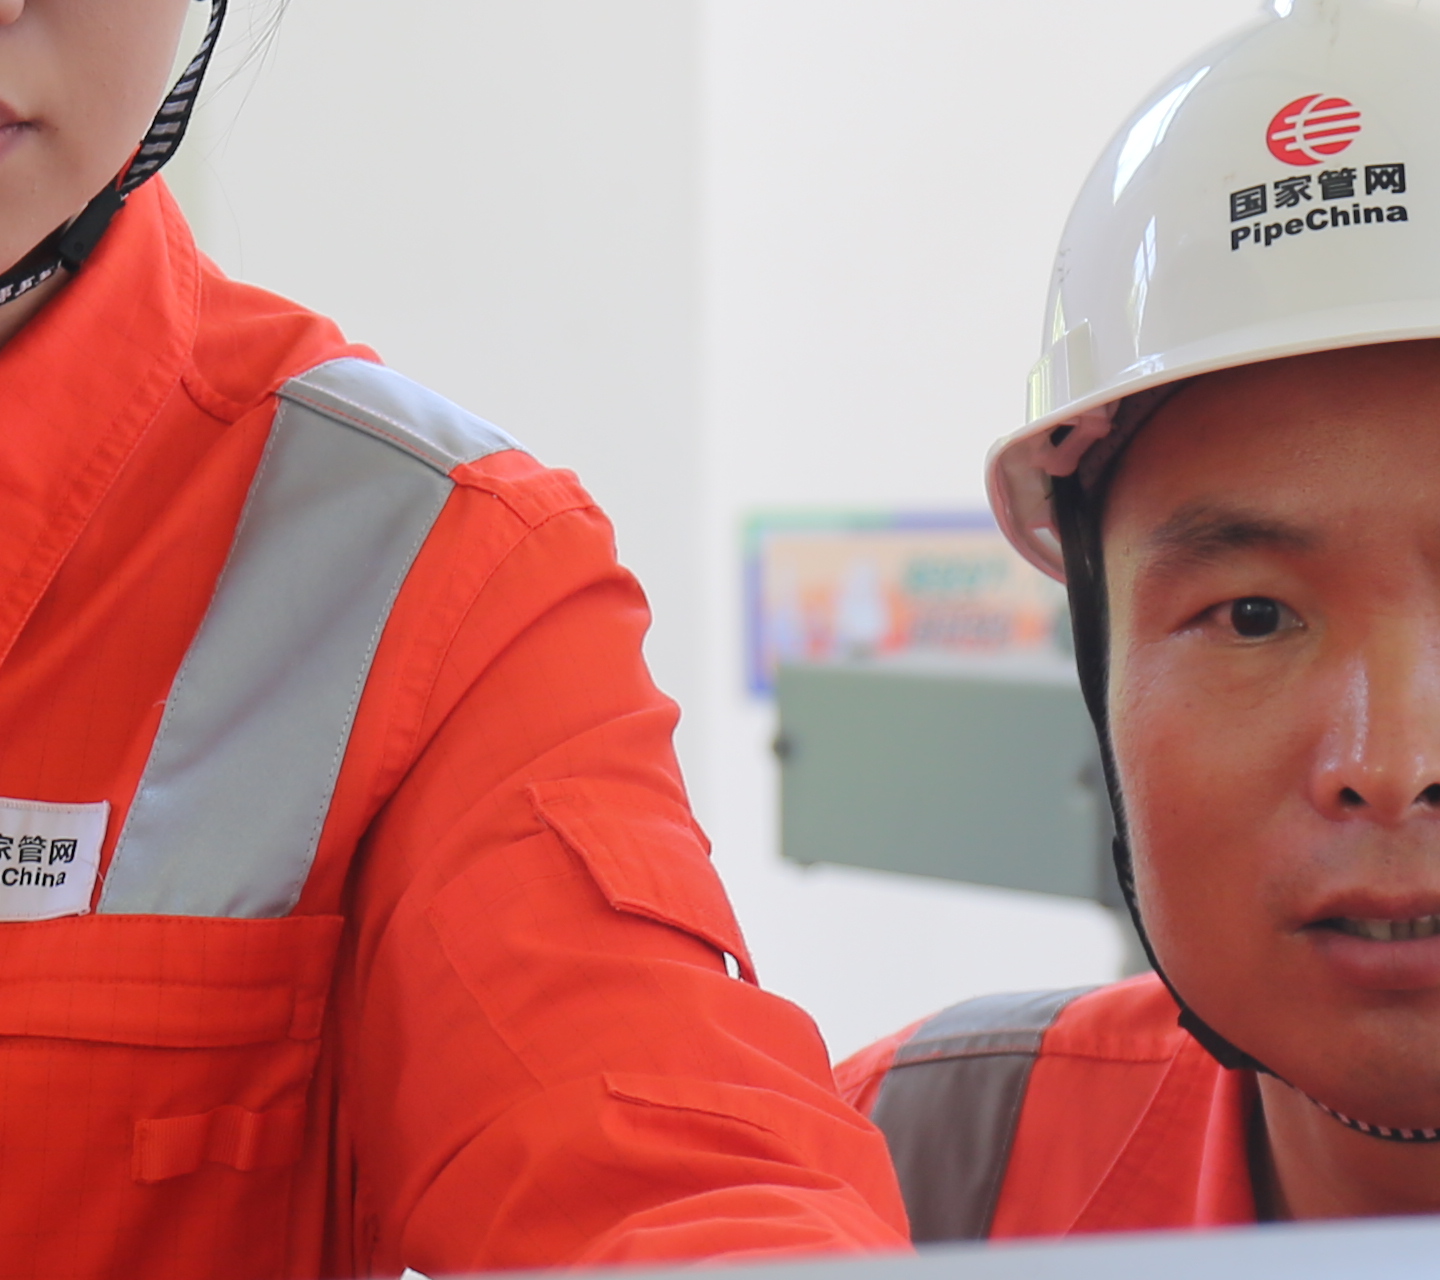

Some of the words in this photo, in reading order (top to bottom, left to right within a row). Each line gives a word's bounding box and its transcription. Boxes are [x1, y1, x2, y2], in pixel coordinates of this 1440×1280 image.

[1230, 163, 1406, 222] 国家管网
[1231, 203, 1409, 251] PipeChina
